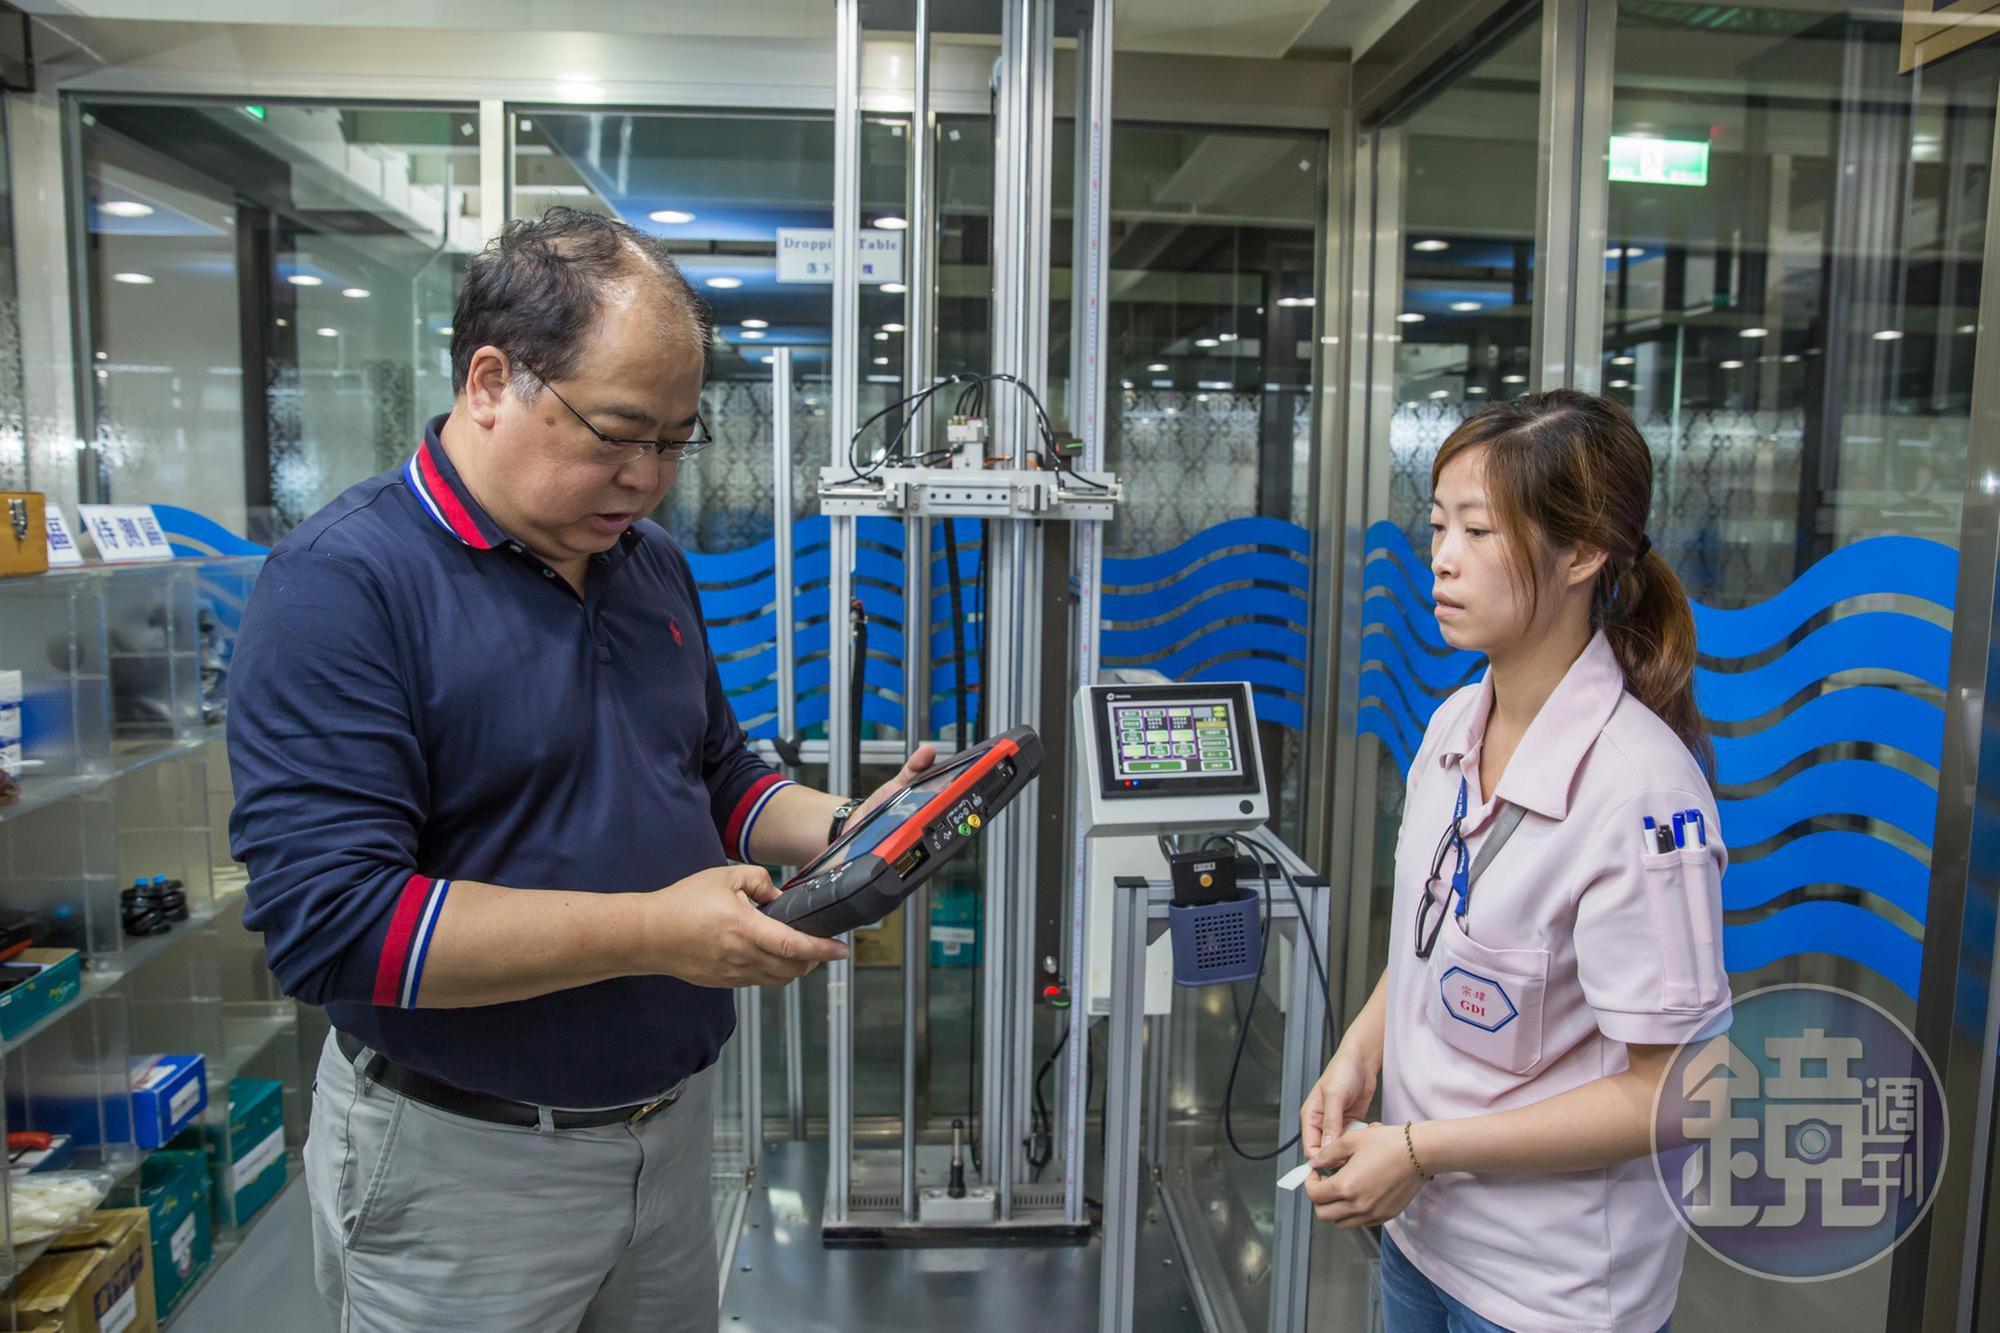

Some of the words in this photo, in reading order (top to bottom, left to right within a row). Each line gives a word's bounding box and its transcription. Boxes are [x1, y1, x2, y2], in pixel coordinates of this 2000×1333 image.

[784, 238, 832, 251] Droppi
[859, 238, 897, 250] Table
[1459, 999, 1486, 1017] GDI
